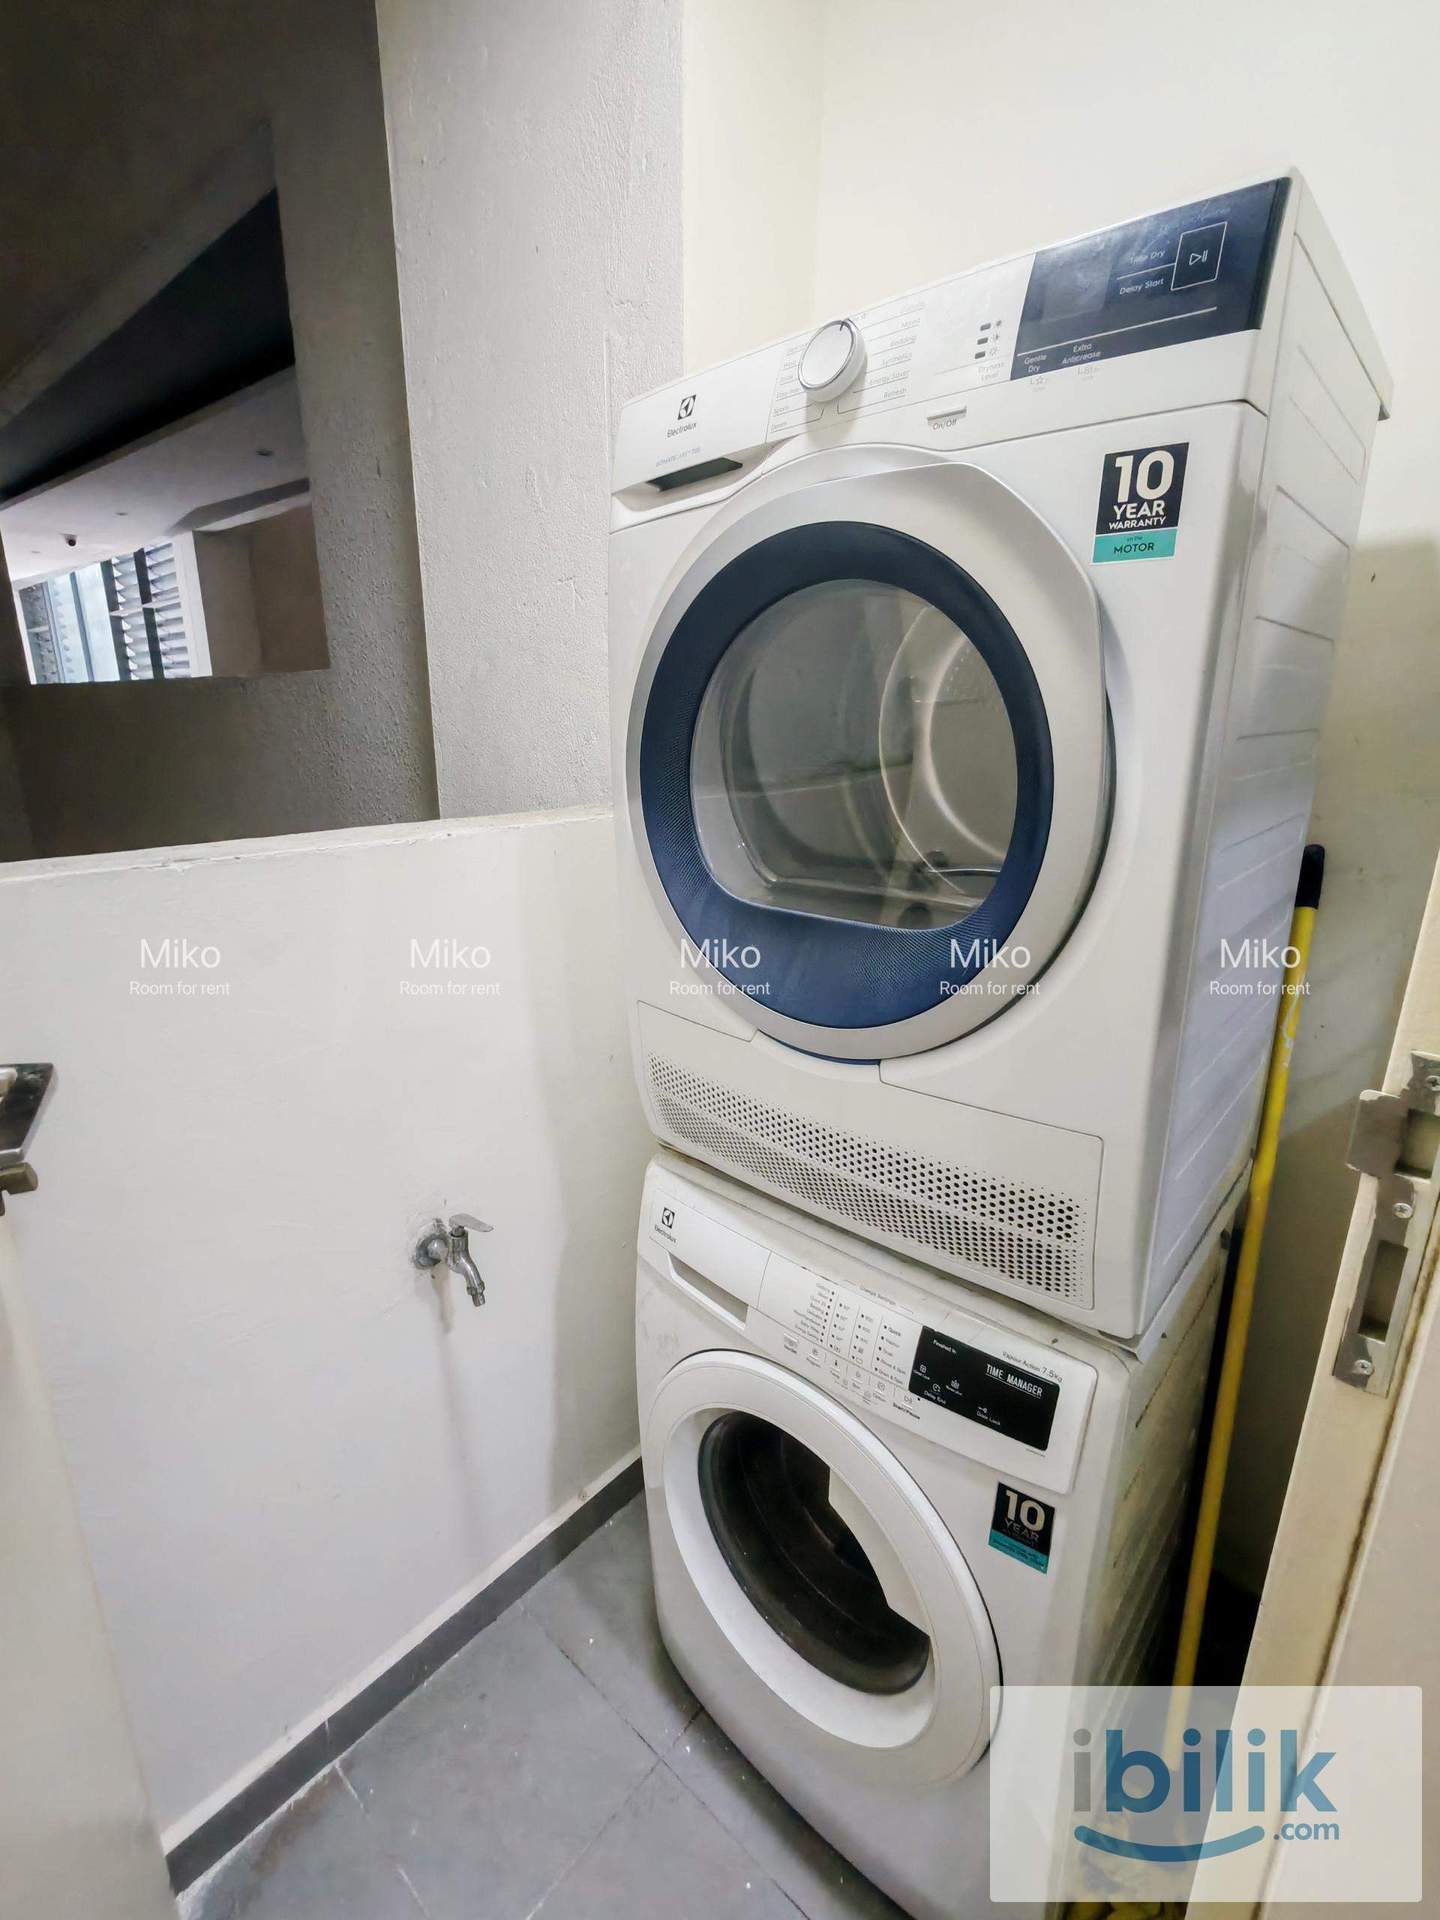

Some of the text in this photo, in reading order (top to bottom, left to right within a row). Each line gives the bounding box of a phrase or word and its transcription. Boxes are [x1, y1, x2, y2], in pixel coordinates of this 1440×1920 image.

[1150, 249, 1166, 262] Dry
[1120, 278, 1165, 295] Delay Start
[1073, 343, 1092, 353] Extra
[1024, 354, 1048, 365] Gentle
[1061, 351, 1102, 365] Anticrease
[1028, 364, 1041, 373] Dry
[667, 422, 697, 438] Electrolux
[932, 418, 959, 431] On/Off
[1115, 450, 1175, 503] 10
[1113, 500, 1166, 520] YEAR
[1108, 516, 1167, 530] WARRANTY
[1113, 542, 1155, 555] MOTOR
[986, 1364, 1043, 1398] TIME MANAGER
[1006, 1489, 1046, 1531] 10
[1004, 1517, 1040, 1542] YEAR
